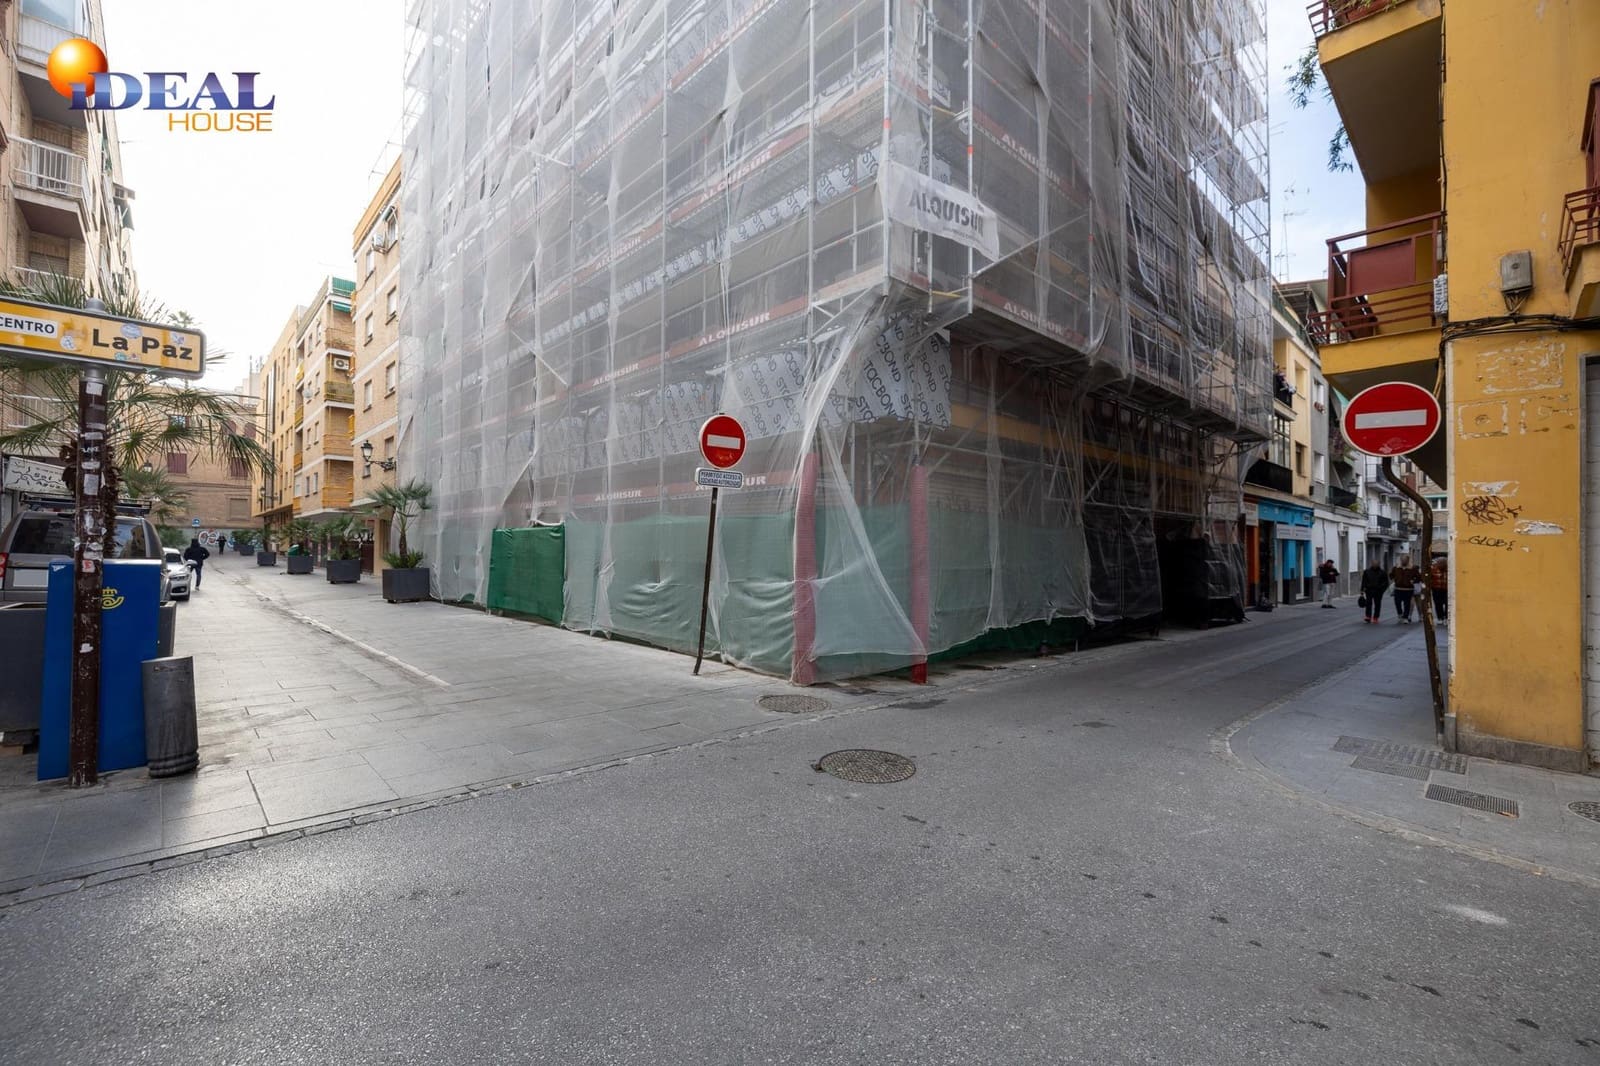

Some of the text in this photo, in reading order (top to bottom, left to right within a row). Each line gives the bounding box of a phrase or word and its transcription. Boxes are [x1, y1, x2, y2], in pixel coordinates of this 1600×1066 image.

[698, 312, 771, 347] ALQUISUR
[1003, 302, 1063, 337] ALQUIUR
[92, 329, 193, 360] La Paz
